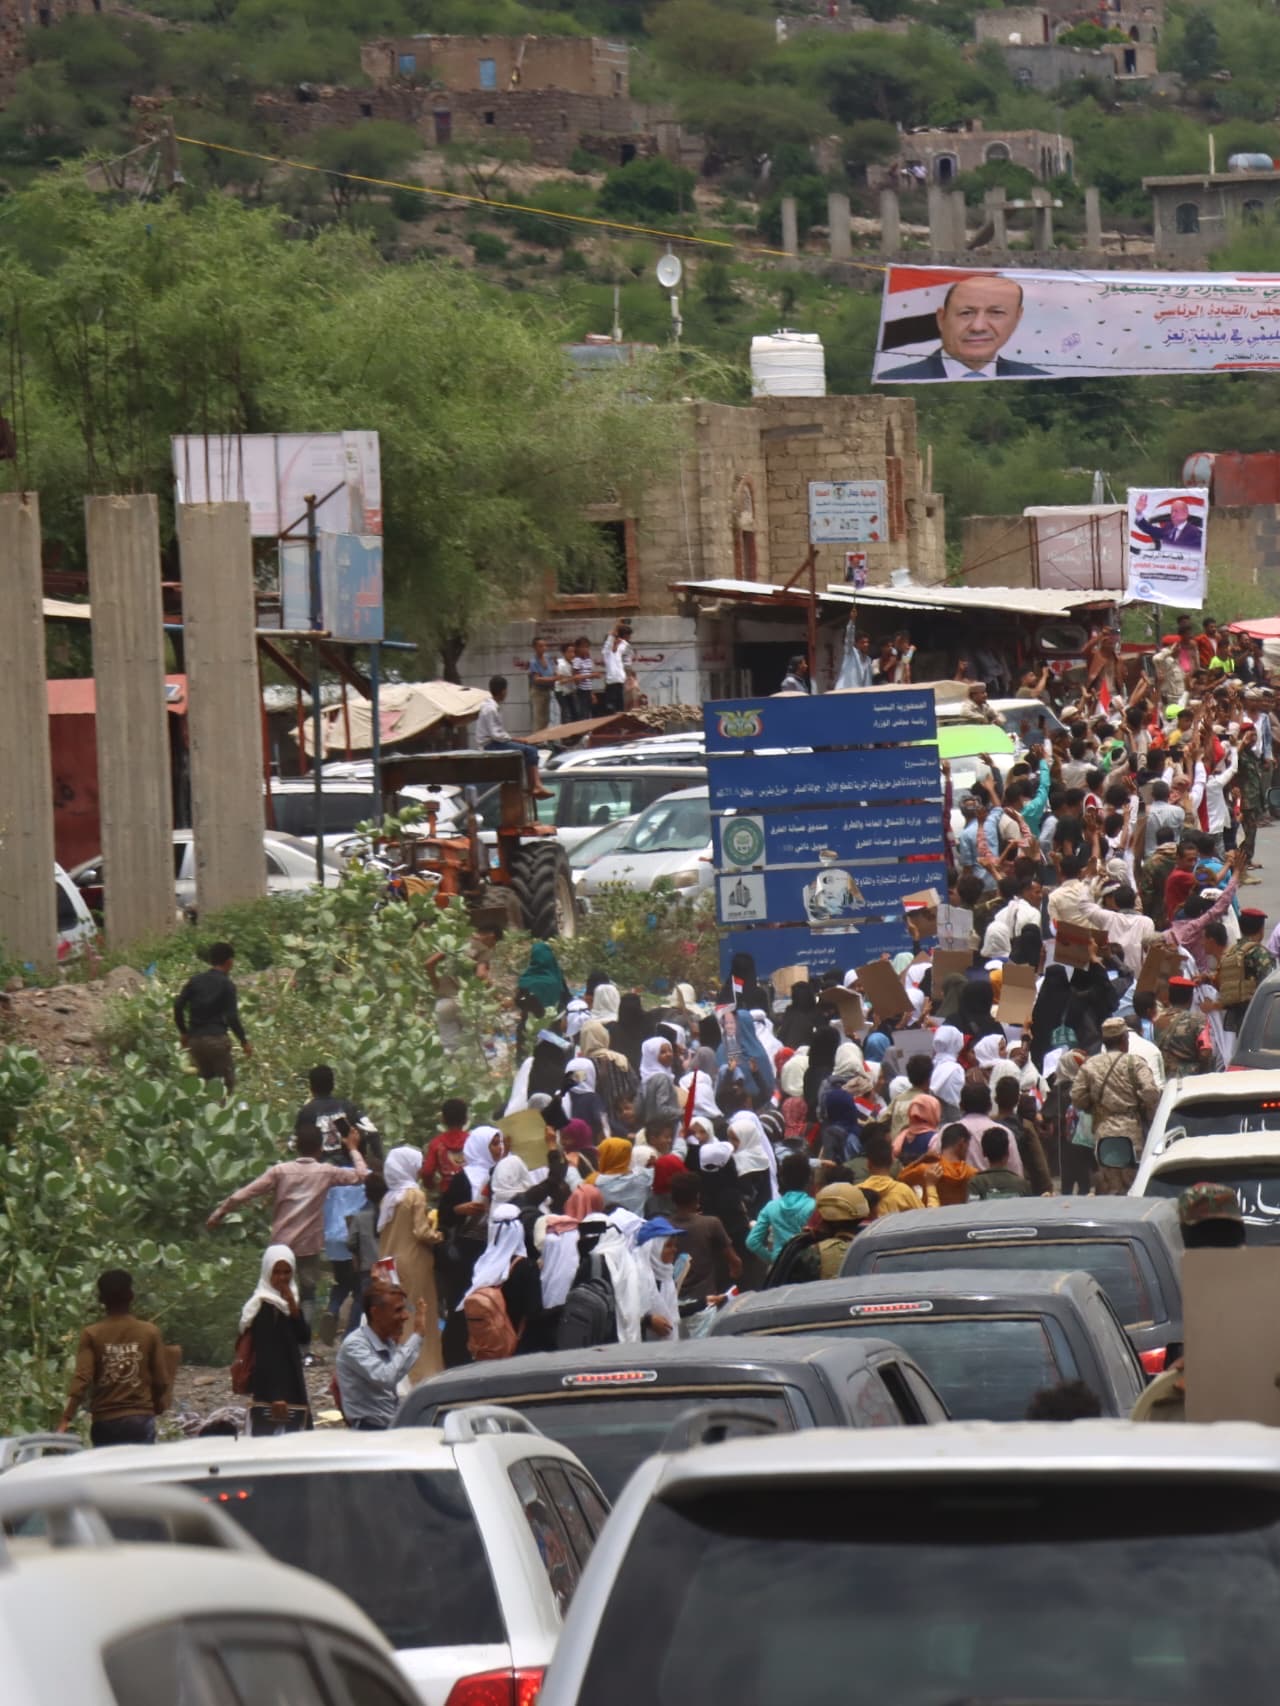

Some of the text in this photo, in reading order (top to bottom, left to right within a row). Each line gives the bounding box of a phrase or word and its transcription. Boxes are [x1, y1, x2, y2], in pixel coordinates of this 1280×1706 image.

[1154, 304, 1204, 321] الرئاسي
[1207, 304, 1248, 317] القيادة
[1162, 330, 1185, 345] تعز
[1188, 330, 1228, 342] مدينة
[1231, 329, 1244, 341] في
